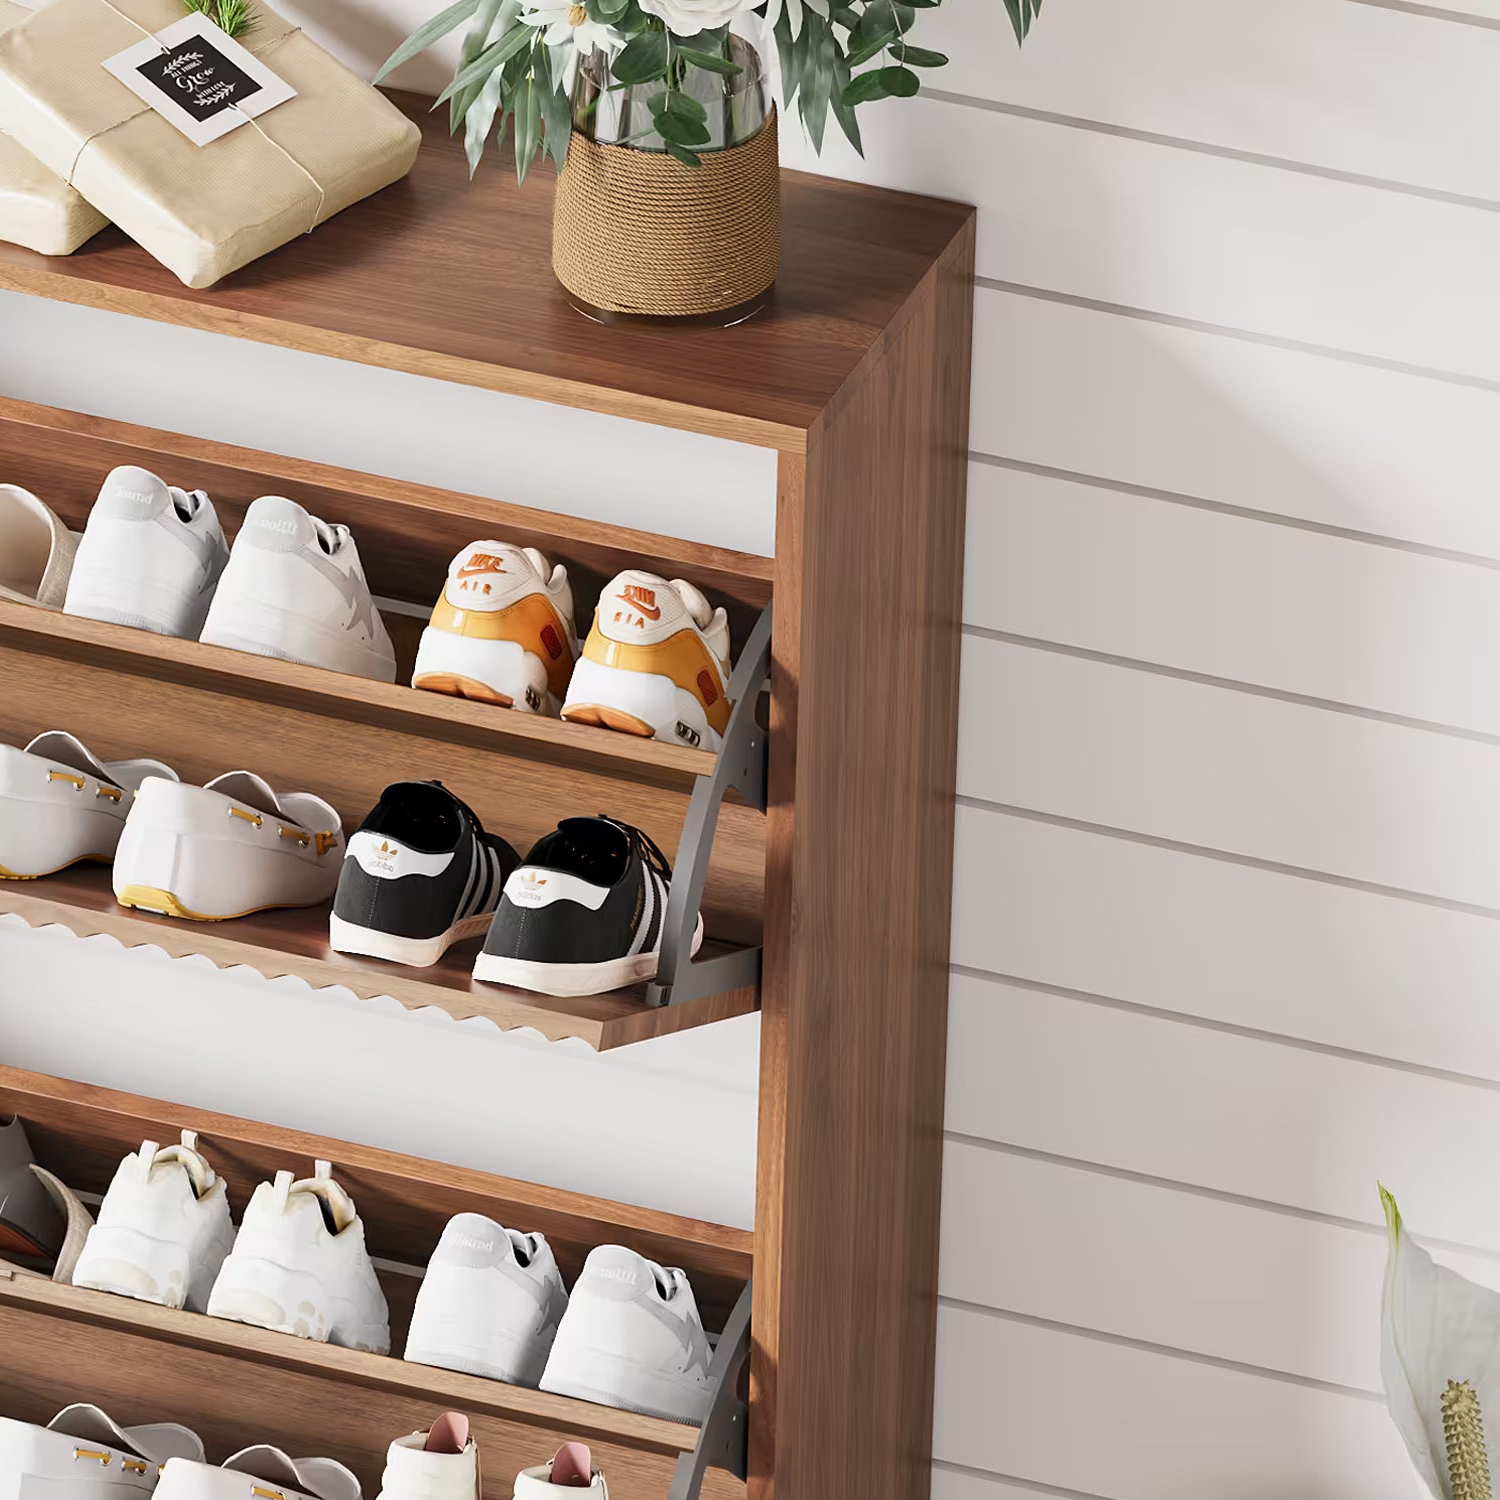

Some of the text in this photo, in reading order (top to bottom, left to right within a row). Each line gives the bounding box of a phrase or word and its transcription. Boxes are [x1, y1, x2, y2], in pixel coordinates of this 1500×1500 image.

[175, 67, 215, 93] Grow
[466, 553, 504, 569] NIKE
[460, 580, 492, 596] AIR
